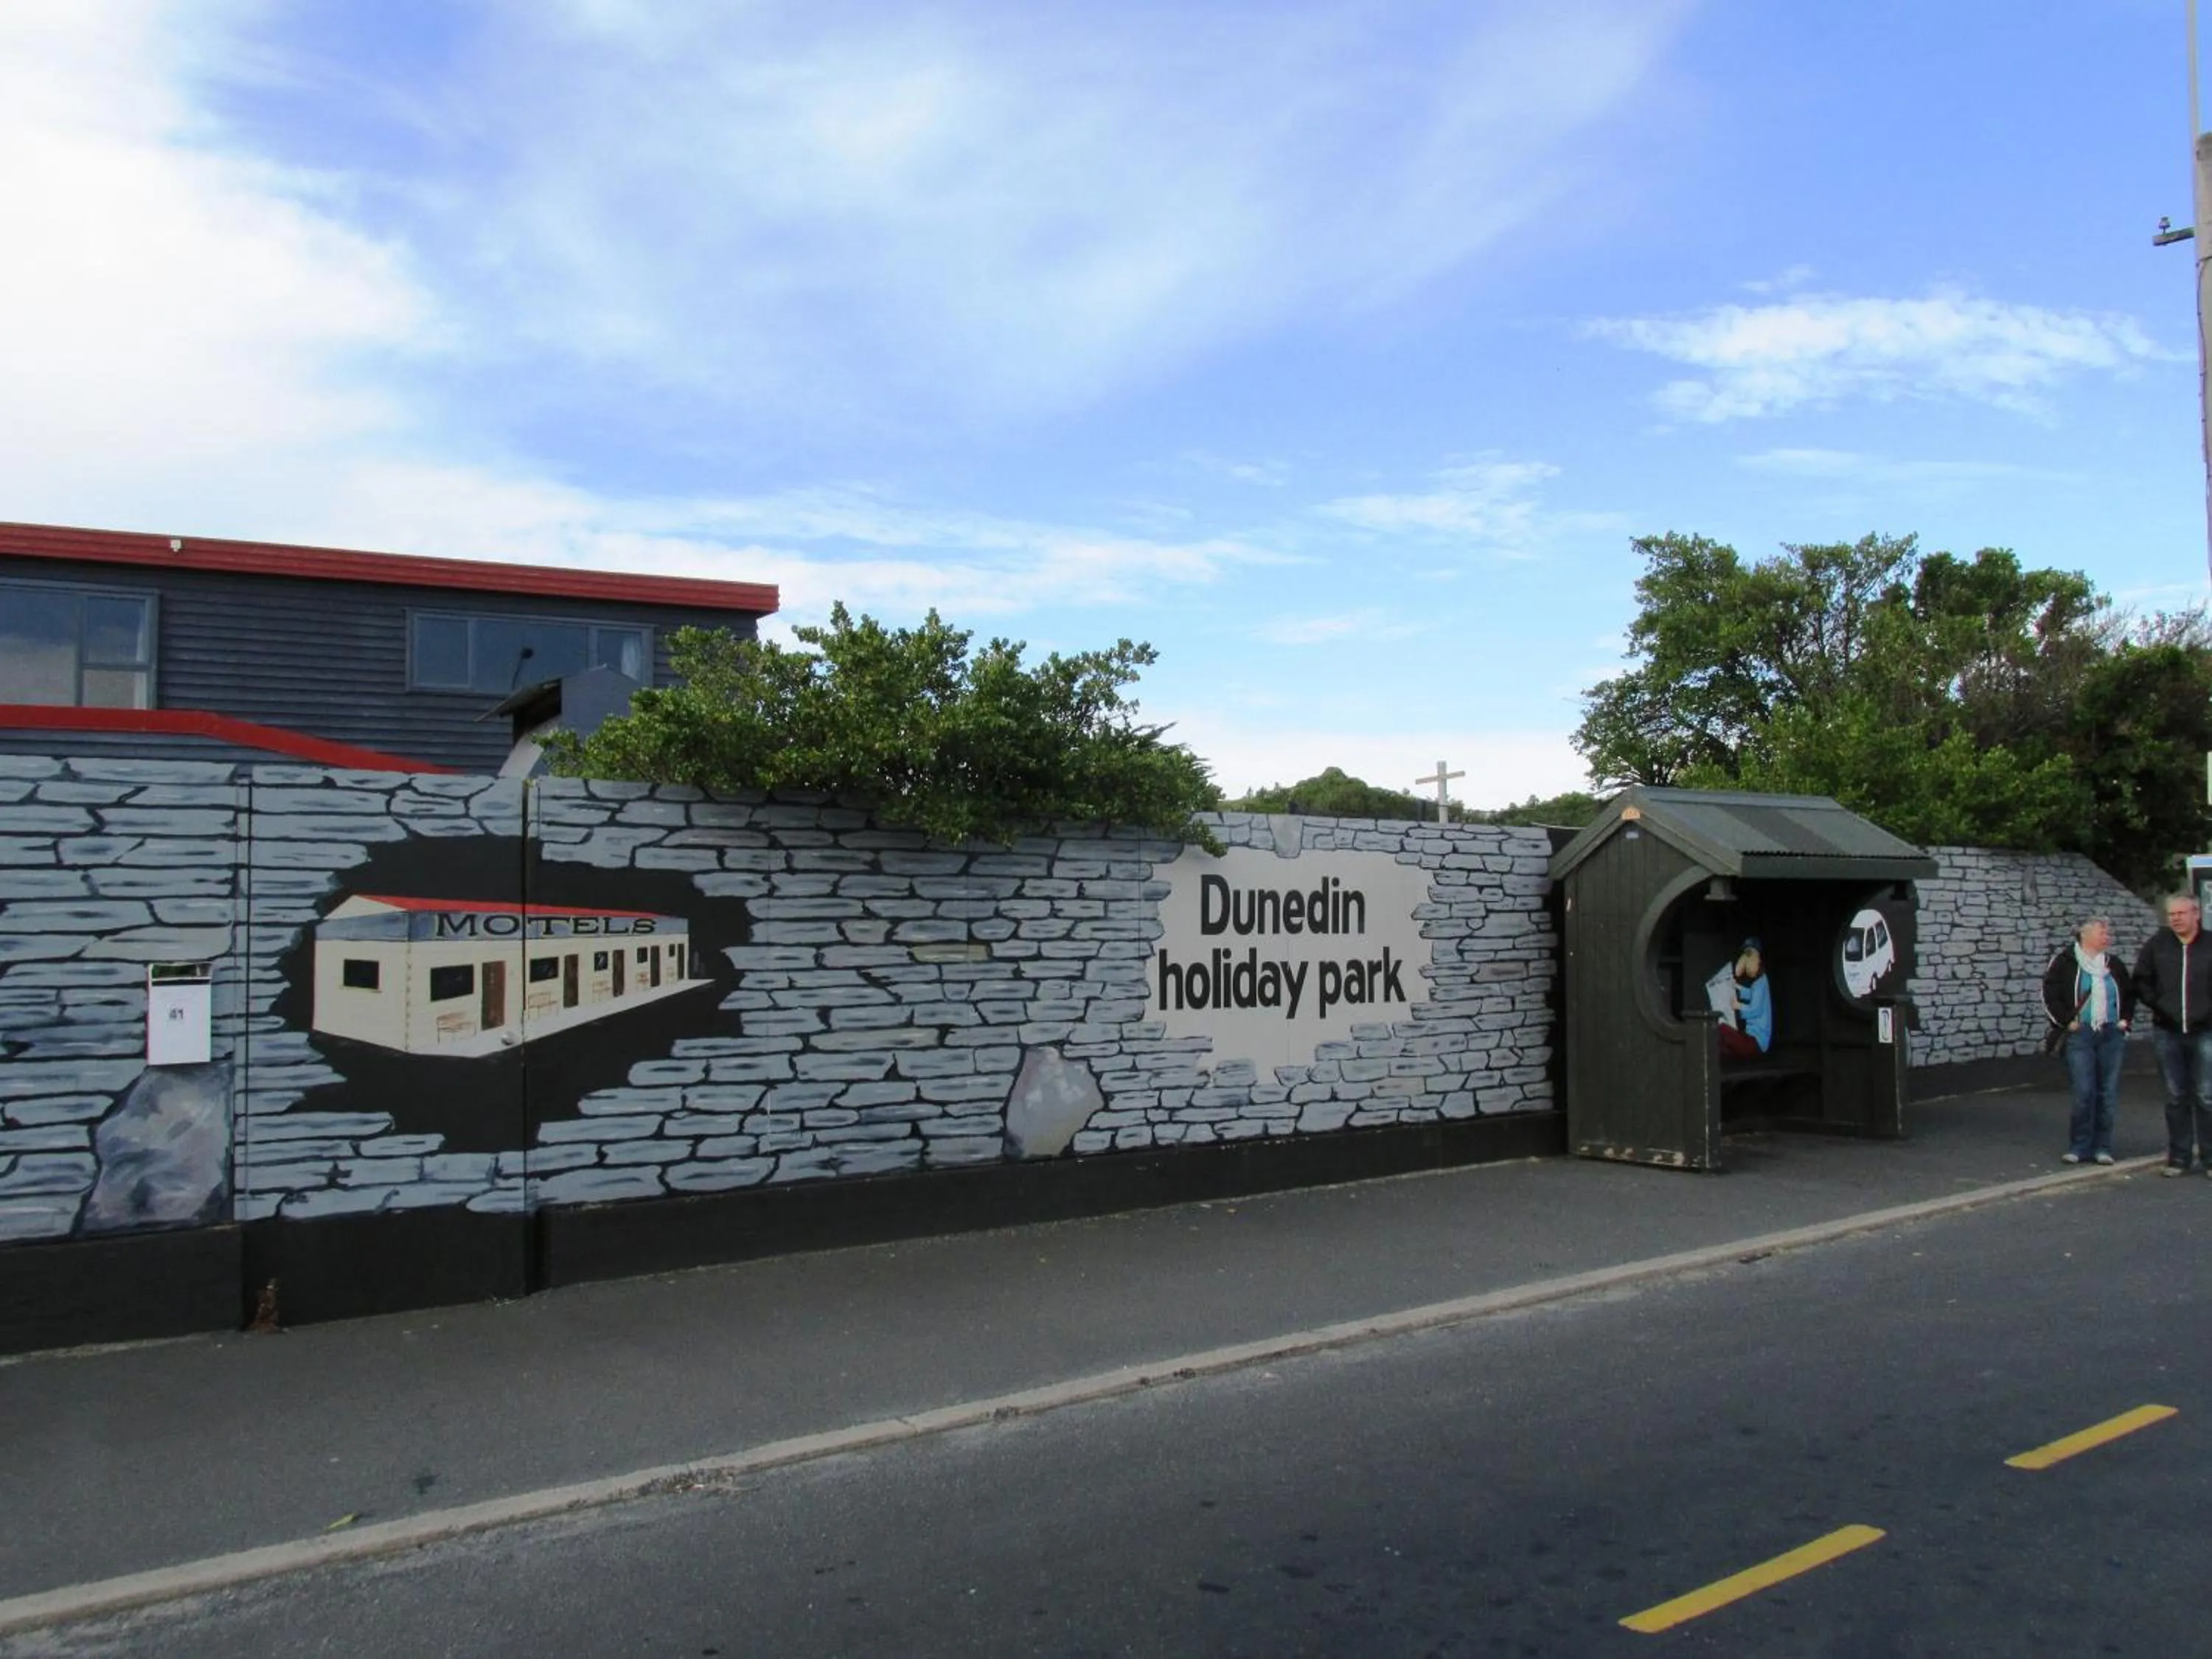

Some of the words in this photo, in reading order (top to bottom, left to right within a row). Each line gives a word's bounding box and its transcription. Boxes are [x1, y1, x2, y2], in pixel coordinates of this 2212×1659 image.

[435, 912, 657, 937] MOTELS
[1200, 874, 1366, 936] Dunedin
[1158, 947, 1310, 1020] holiday
[1318, 946, 1407, 1020] park
